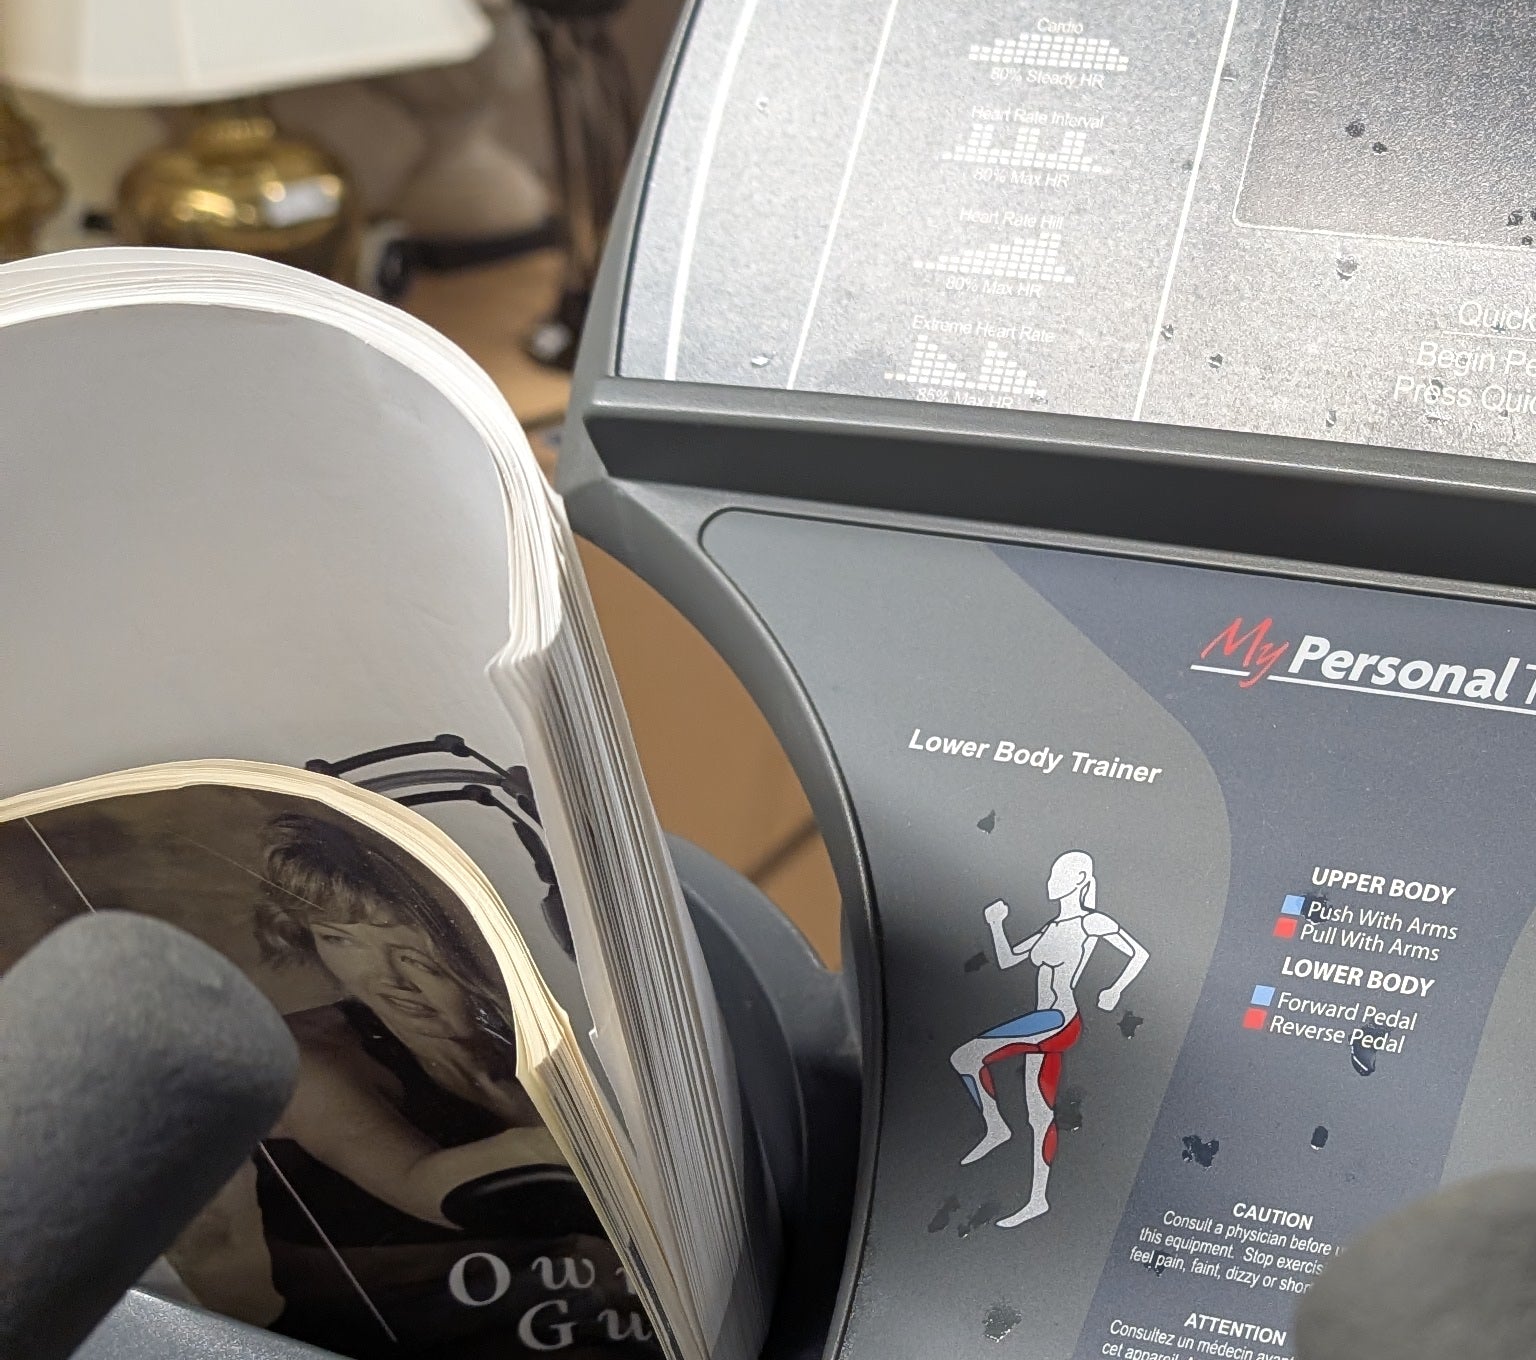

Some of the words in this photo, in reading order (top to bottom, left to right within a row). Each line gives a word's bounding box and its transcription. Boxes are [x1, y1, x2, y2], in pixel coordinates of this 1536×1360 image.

[1037, 17, 1084, 35] Cardio
[989, 66, 1023, 82] 80%
[1026, 69, 1078, 90] Steady
[1080, 73, 1106, 90] HR
[970, 105, 1012, 122] Heart
[1013, 108, 1048, 126] Rate
[1050, 112, 1105, 130] Interval
[1010, 170, 1042, 187] Max
[1044, 173, 1070, 189] HR
[912, 314, 973, 336] Extreme
[975, 320, 1017, 338] Heart
[1018, 325, 1056, 344] Rate
[1457, 299, 1536, 332] Quick
[1415, 340, 1496, 376] Begin
[952, 390, 986, 406] Max
[988, 395, 1014, 409] HR
[1392, 375, 1472, 408] Press
[1200, 616, 1290, 689] My
[1287, 634, 1521, 703] Personal
[908, 727, 991, 759] Lower
[993, 740, 1064, 774] Body
[1070, 751, 1163, 784] Trainer
[1311, 866, 1386, 895] UPPER
[1388, 878, 1457, 905] BODY
[1307, 900, 1354, 924] Push
[1358, 908, 1403, 932] With
[1406, 916, 1459, 940] Arms
[1299, 922, 1338, 945] Pull
[1340, 929, 1384, 952] With
[1387, 938, 1441, 962] Arms
[1281, 956, 1364, 987] LOWER
[1366, 970, 1435, 998] BODY
[1276, 991, 1360, 1022] Forward
[1362, 1005, 1418, 1031] Pedal
[1269, 1014, 1346, 1044] Reverse
[1349, 1027, 1406, 1054] Pedal
[1162, 1210, 1214, 1233] Consult
[1213, 1222, 1224, 1235] a
[1224, 1223, 1287, 1248] physician
[1289, 1234, 1332, 1257] before
[1232, 1202, 1314, 1231] CAUTION
[1139, 1227, 1162, 1245] this
[1164, 1234, 1235, 1259] equipment.
[1242, 1246, 1274, 1269] Stop
[1276, 1255, 1326, 1277] exercis
[1129, 1245, 1155, 1264] feel
[1155, 1252, 1186, 1273] pain,
[1190, 1257, 1222, 1280] faint,
[1225, 1265, 1260, 1289] dizzy
[1262, 1275, 1277, 1288] or
[1278, 1276, 1312, 1295] shor
[1109, 1319, 1176, 1346] Consultez
[1177, 1335, 1195, 1350] un
[1184, 1312, 1287, 1347] ATTENTION
[1101, 1341, 1122, 1357] cet
